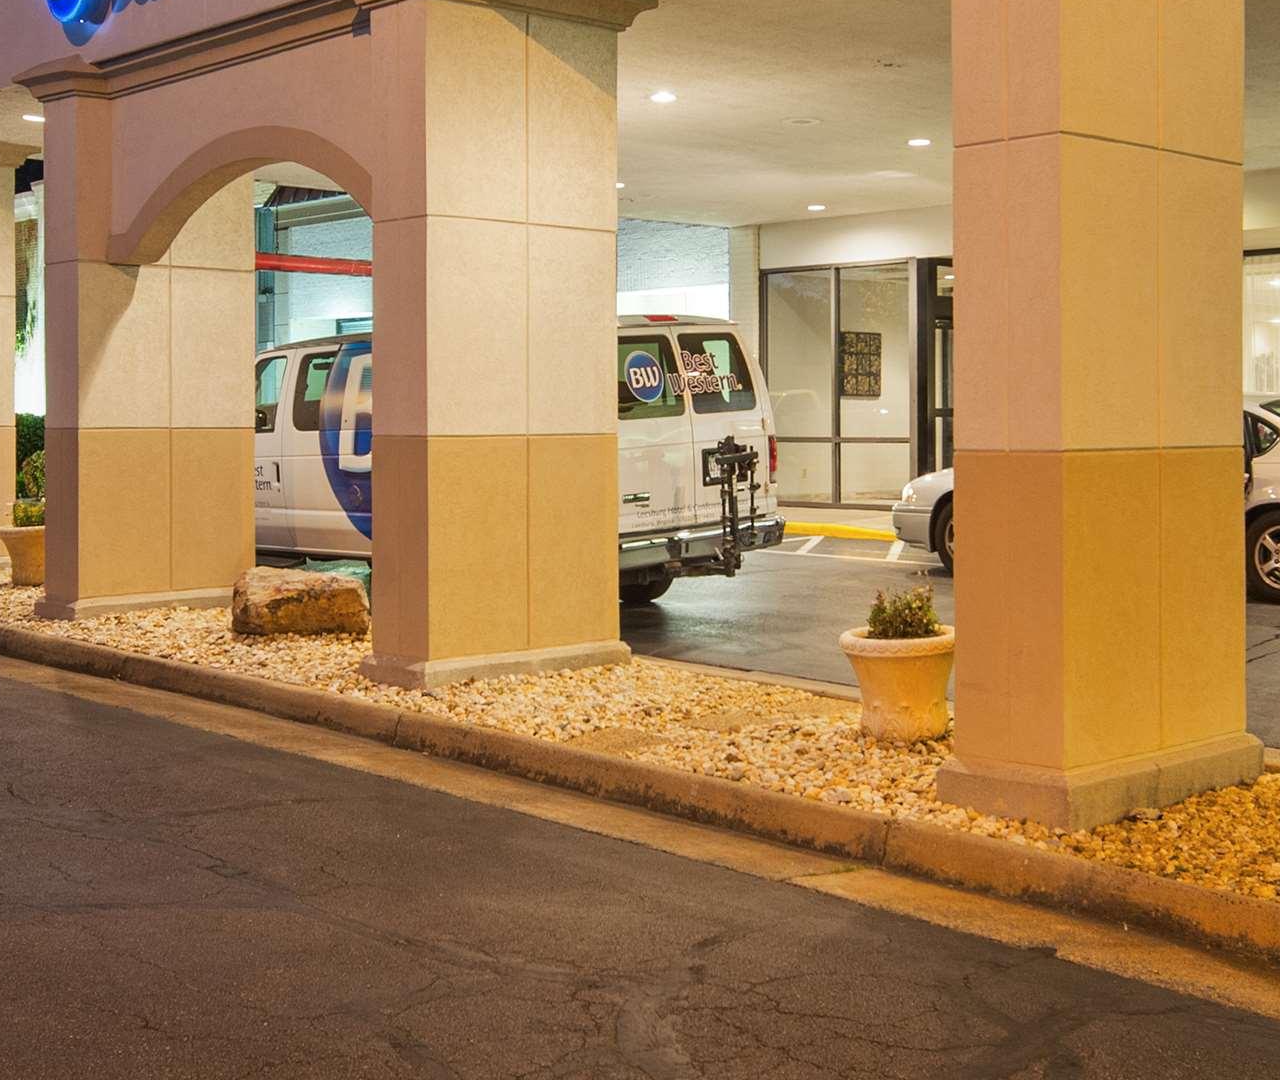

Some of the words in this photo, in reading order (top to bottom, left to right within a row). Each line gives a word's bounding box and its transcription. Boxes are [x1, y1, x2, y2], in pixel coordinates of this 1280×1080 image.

[681, 350, 719, 372] Best
[629, 366, 660, 389] BW
[667, 372, 738, 396] Western
[255, 465, 264, 477] st
[255, 480, 272, 491] tern
